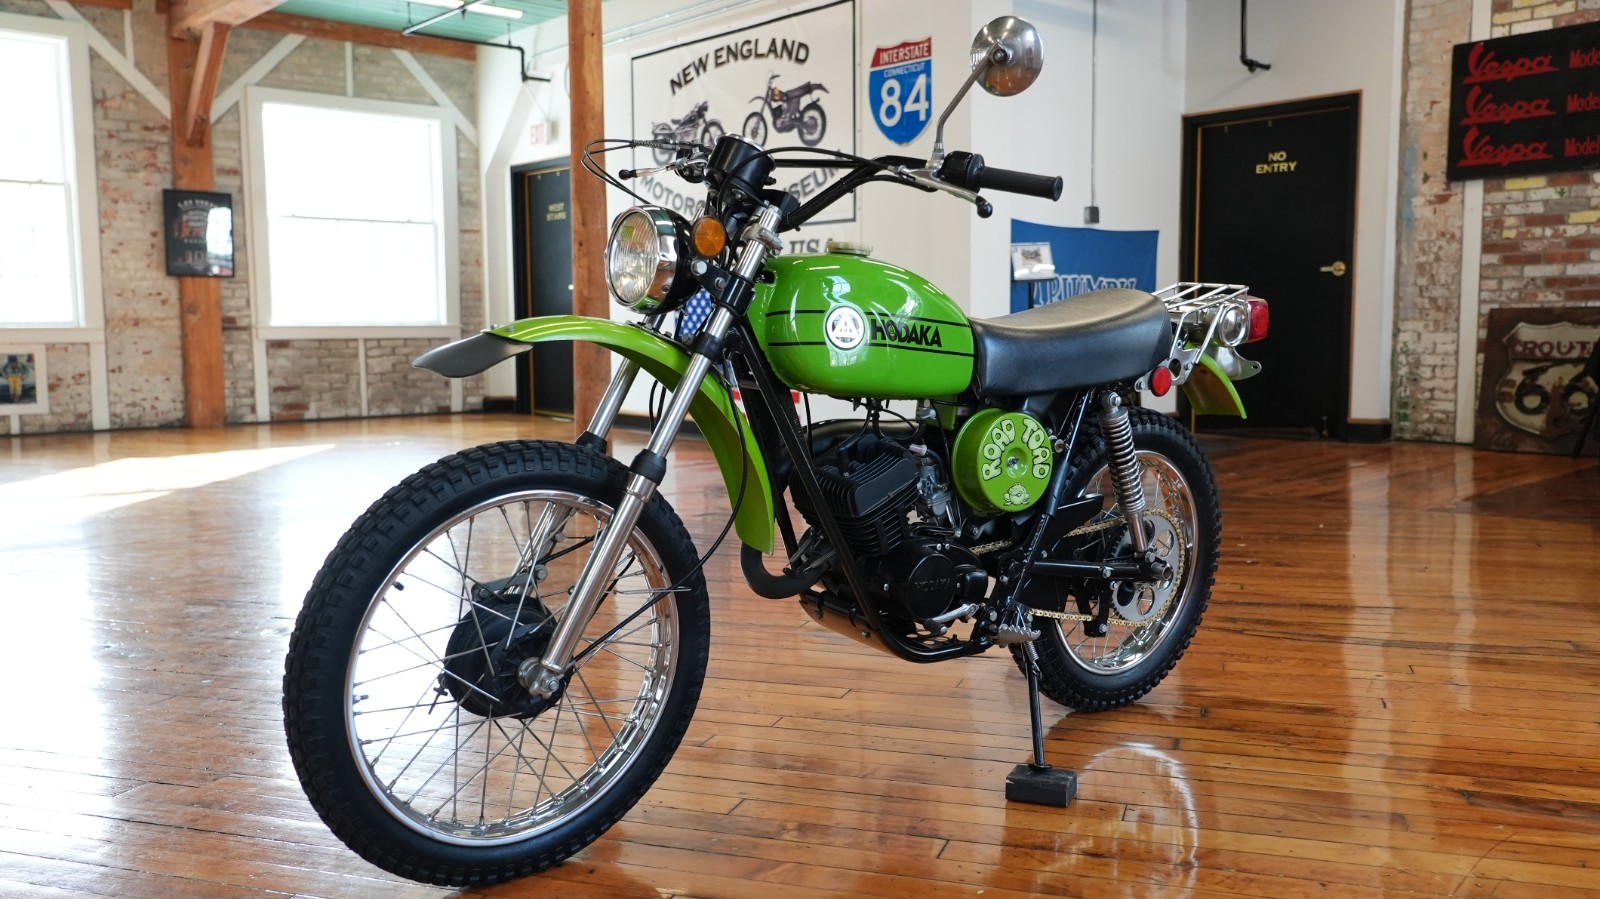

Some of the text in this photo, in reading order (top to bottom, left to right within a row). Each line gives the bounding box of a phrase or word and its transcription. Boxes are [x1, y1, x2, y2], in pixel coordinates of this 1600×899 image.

[669, 38, 810, 96] NEW ENGLAND
[880, 42, 929, 65] INTERSTATE
[884, 62, 925, 78] CONNECTICUT
[1462, 42, 1560, 84] Vespa
[879, 73, 930, 127] 84
[1460, 84, 1557, 125] Vespa
[1268, 151, 1287, 162] NO
[1456, 126, 1554, 167] Vespa
[1255, 161, 1298, 174] ENTRY
[790, 238, 833, 253] US
[871, 318, 942, 348] HODAKA
[1516, 364, 1594, 417] 66
[981, 417, 1051, 481] ROAD TOAD
